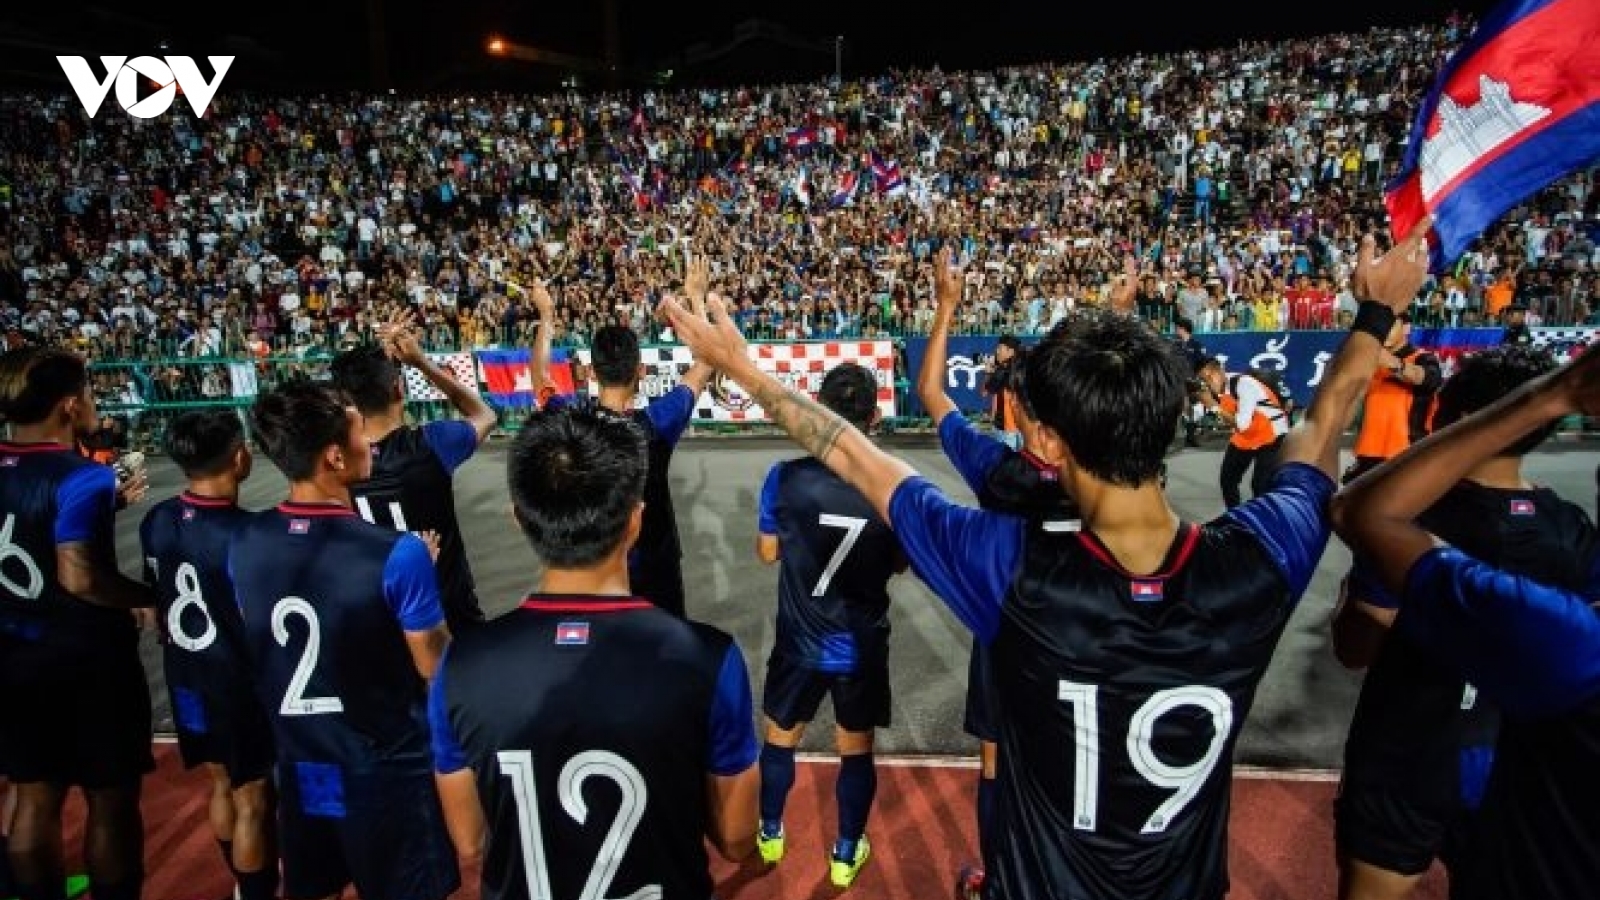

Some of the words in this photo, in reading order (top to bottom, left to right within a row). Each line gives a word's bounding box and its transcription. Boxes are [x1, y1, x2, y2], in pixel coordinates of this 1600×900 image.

[811, 513, 868, 597] 7
[271, 596, 344, 715] 2
[1057, 679, 1233, 834] 19
[497, 750, 663, 900] 12
